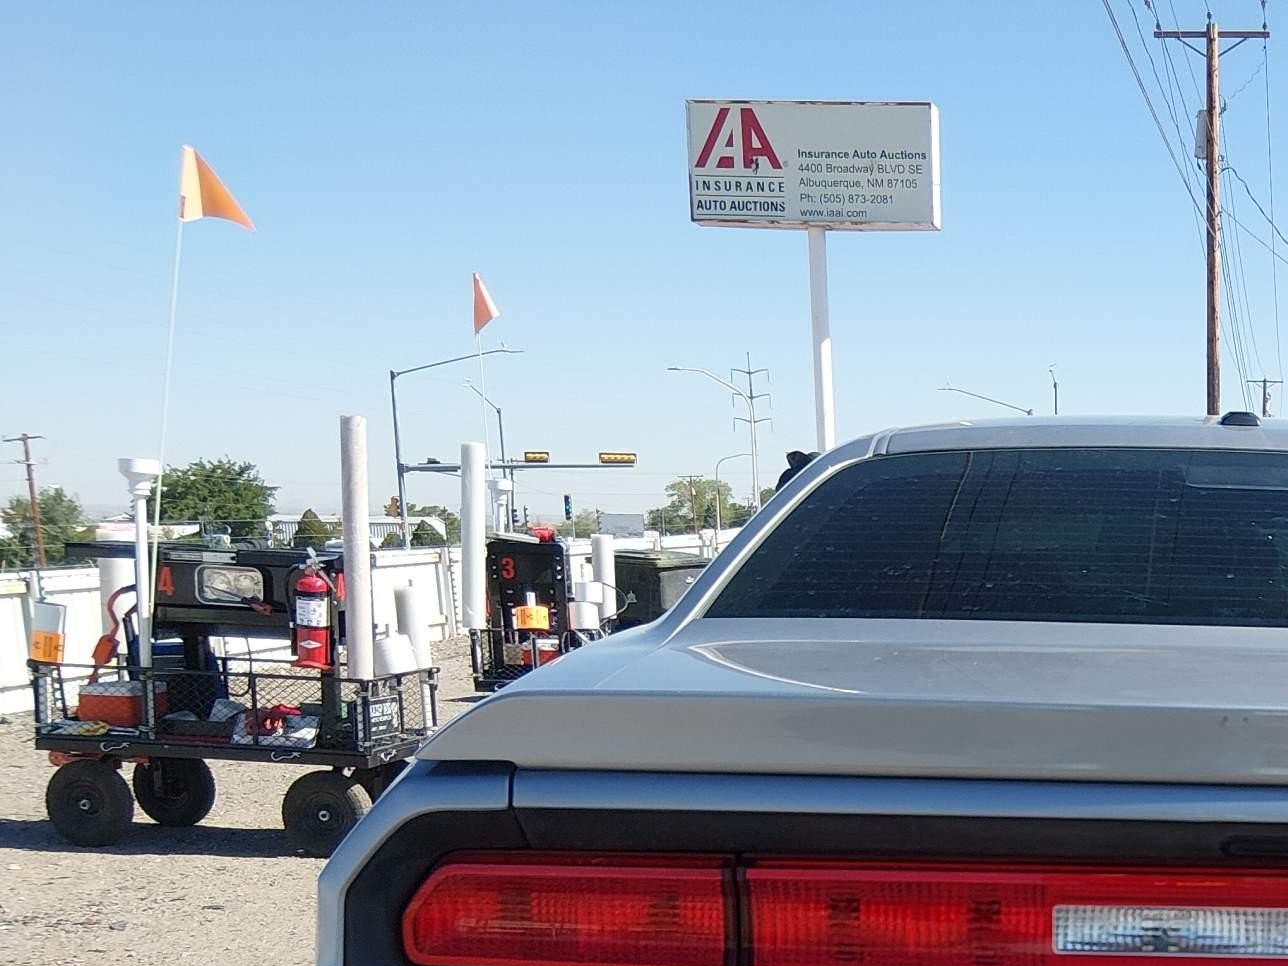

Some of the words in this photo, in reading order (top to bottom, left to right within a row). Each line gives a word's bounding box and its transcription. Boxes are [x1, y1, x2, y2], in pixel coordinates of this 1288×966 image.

[797, 149, 850, 159] Insurance
[852, 150, 877, 159] Auto
[880, 150, 927, 160] Auctions
[798, 162, 823, 173] 4400
[825, 163, 874, 176] Broadway
[878, 164, 905, 174] BLVD
[908, 164, 923, 174] SE
[695, 180, 785, 193] INSURANCE
[799, 177, 864, 189] Albuquerque,
[867, 178, 884, 188] NM
[887, 178, 918, 188] 87105
[696, 199, 727, 211] AUTO
[729, 200, 785, 212] AUCTIONS
[800, 193, 816, 203] Ph:
[819, 194, 845, 205] (505)
[848, 194, 893, 204] 873-2081
[800, 208, 867, 218] www.iaai.com
[500, 558, 514, 579] 3
[158, 566, 175, 596] 4
